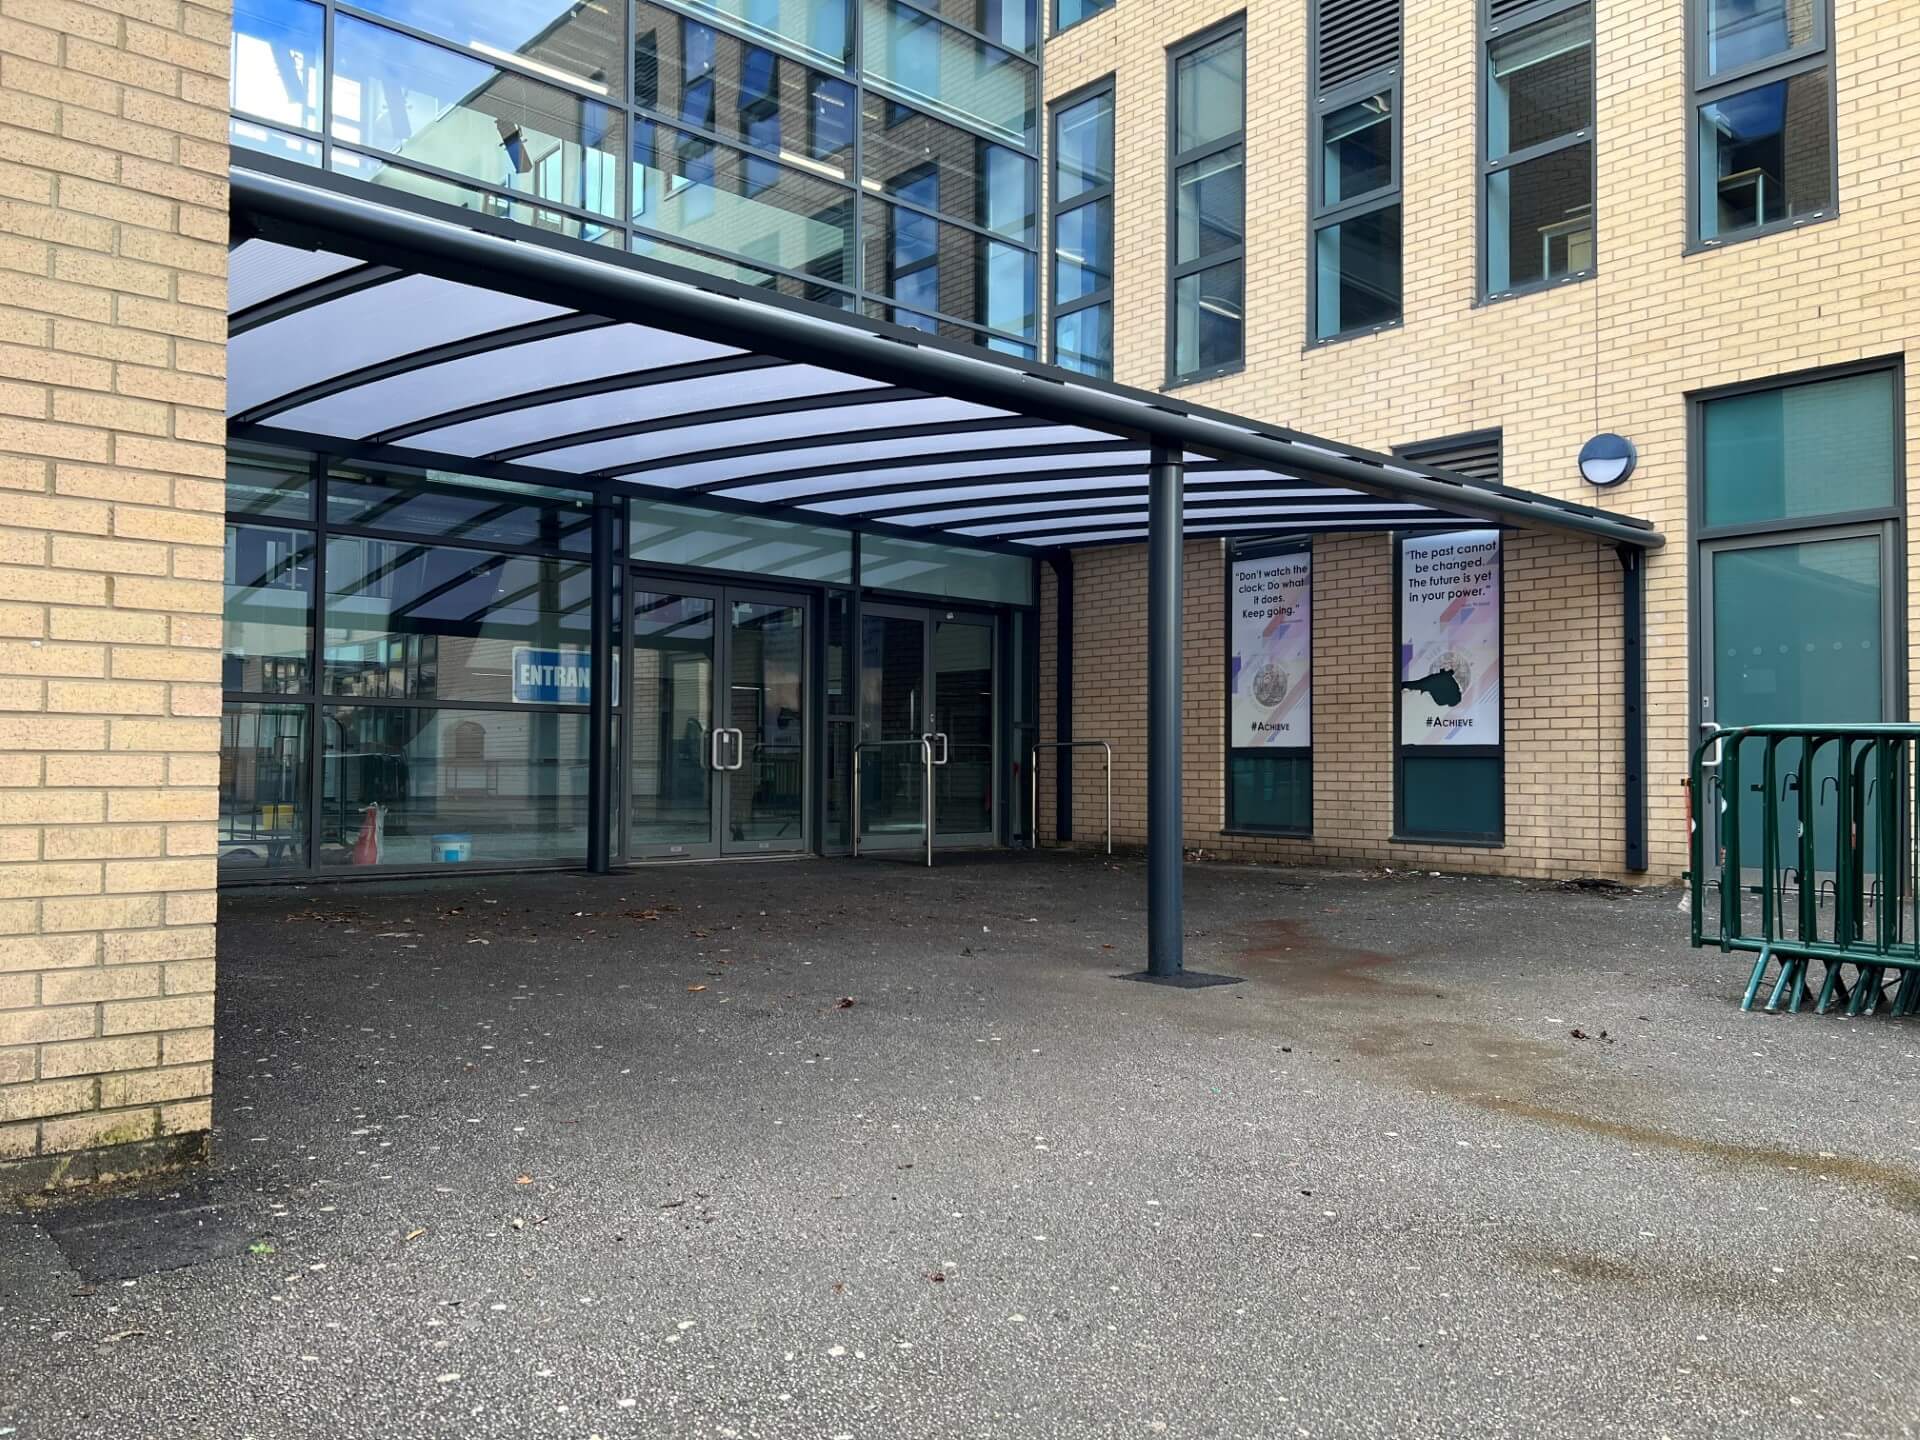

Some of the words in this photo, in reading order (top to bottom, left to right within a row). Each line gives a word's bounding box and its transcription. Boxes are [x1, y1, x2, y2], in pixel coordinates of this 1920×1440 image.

[1431, 545, 1454, 560] past
[1457, 540, 1496, 554] cannot
[1415, 563, 1429, 573] be
[1432, 556, 1485, 571] changed.
[1263, 566, 1291, 577] watch
[1293, 565, 1308, 574] the
[1267, 581, 1280, 590] Do
[1282, 578, 1304, 588] what
[1408, 578, 1427, 588] The
[1429, 575, 1460, 586] future
[1463, 573, 1471, 583] is
[1474, 570, 1492, 584] yet
[1253, 595, 1259, 605] it
[1261, 594, 1286, 604] does.
[1409, 592, 1419, 602] in
[1421, 591, 1445, 603] your
[1242, 608, 1265, 619] Keep
[520, 664, 591, 687] ENTRAN
